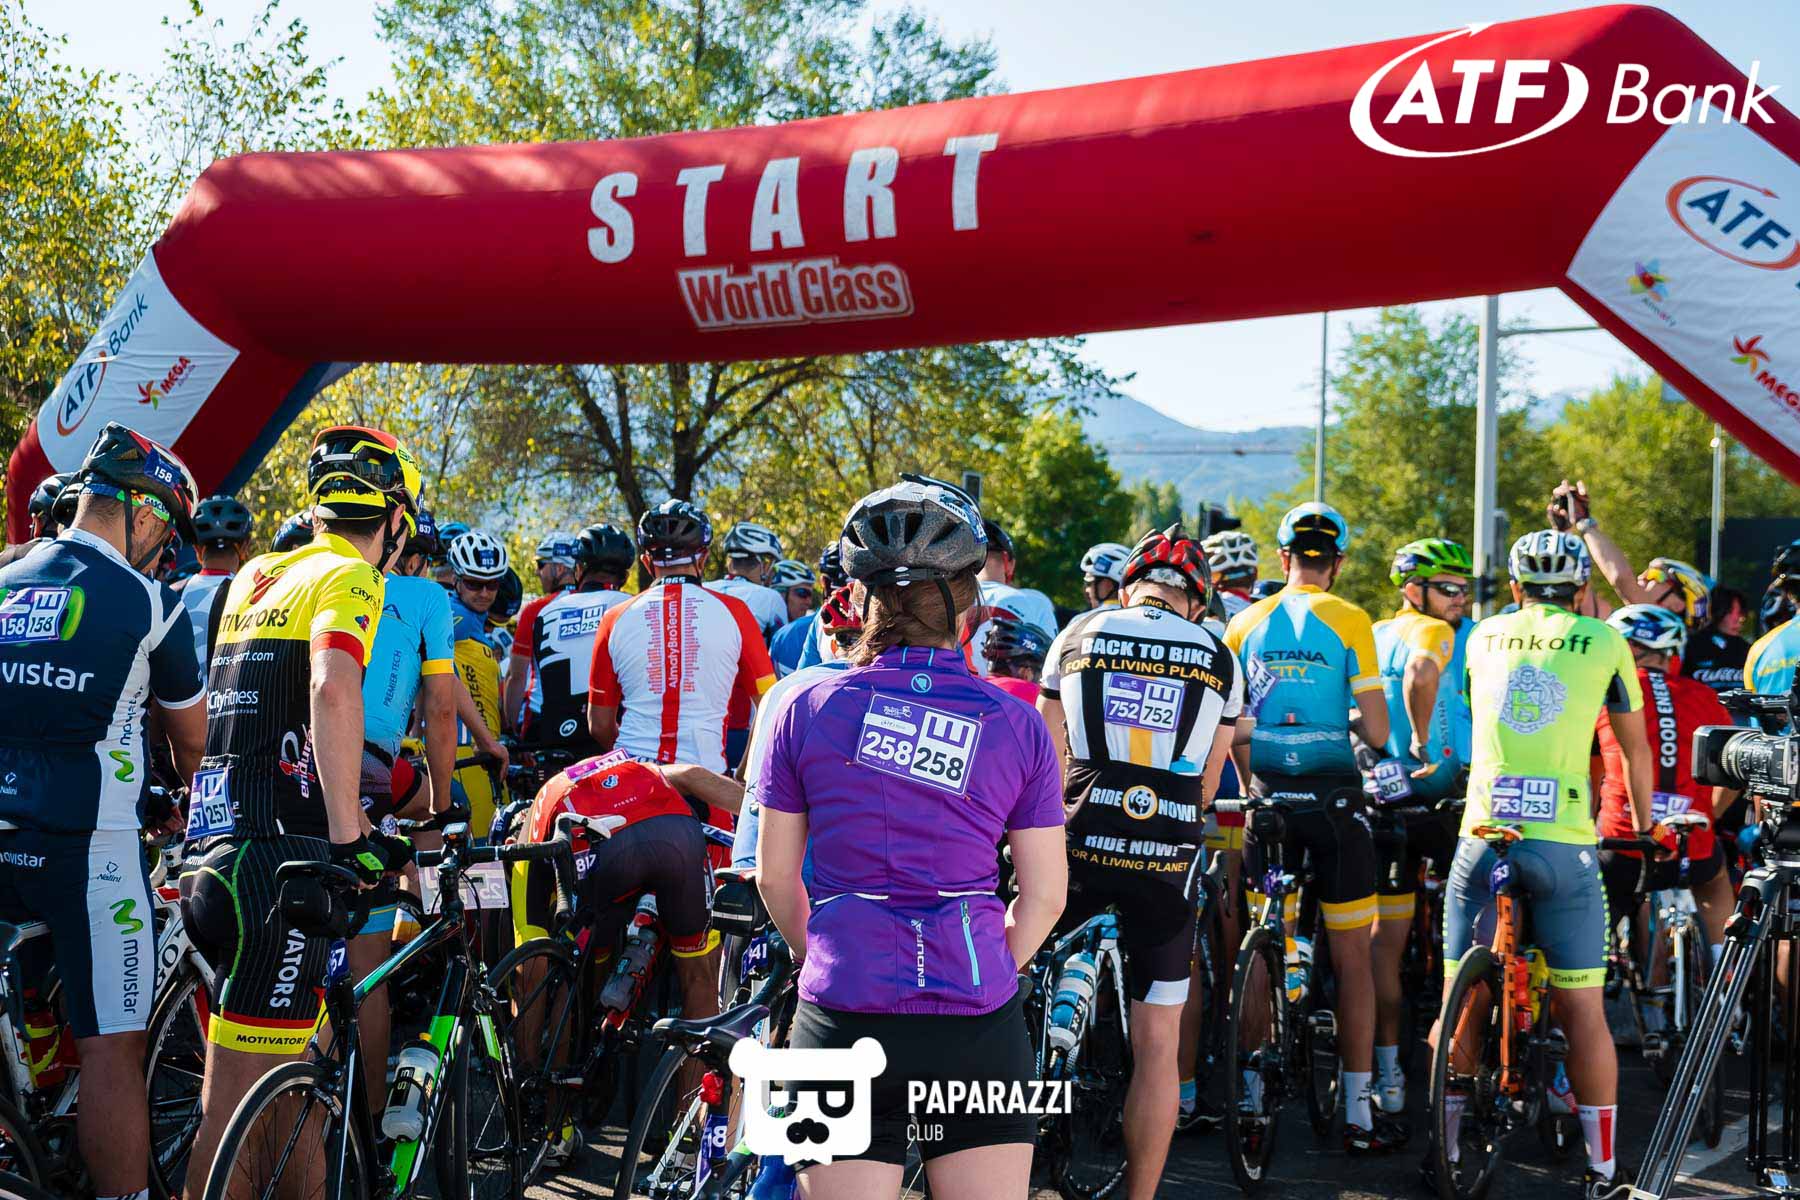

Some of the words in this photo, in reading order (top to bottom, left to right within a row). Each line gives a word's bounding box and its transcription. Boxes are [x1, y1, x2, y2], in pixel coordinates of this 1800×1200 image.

[586, 133, 1000, 264] START
[1686, 188, 1792, 252] ATF
[684, 270, 795, 324] World
[798, 261, 899, 316] Class
[108, 292, 149, 356] Bank
[160, 355, 191, 394] MEGA
[1755, 368, 1800, 413] MEG
[154, 465, 173, 483] 158
[1, 617, 26, 636] 158
[561, 623, 581, 637] 253
[1081, 637, 1135, 657] BACK
[1138, 643, 1165, 660] TO
[1168, 646, 1214, 669] BIKE
[1262, 649, 1329, 666] STANA
[1484, 632, 1593, 655] Tinkoff
[391, 649, 402, 671] TECH
[1065, 657, 1091, 674] FOR
[1094, 658, 1107, 670] A
[1111, 659, 1165, 674] LIVING
[1169, 666, 1224, 692] PLANET
[1107, 700, 1140, 720] 752
[1143, 705, 1174, 725] 752
[861, 731, 913, 766] 258
[913, 746, 964, 782] 258
[1659, 716, 1677, 768] GOOD
[205, 802, 228, 825] 257
[1089, 787, 1124, 807] RIDE
[1157, 798, 1197, 823] NOW!
[1493, 798, 1521, 814] 753
[1523, 800, 1551, 815] 753
[575, 853, 597, 873] 817
[1089, 853, 1099, 864] A
[1102, 856, 1145, 871] LIVING
[1147, 861, 1189, 873] PLANET
[915, 921, 926, 988] ENDURA
[122, 938, 140, 1015] movistar
[235, 1034, 307, 1046] MOTIVATORS
